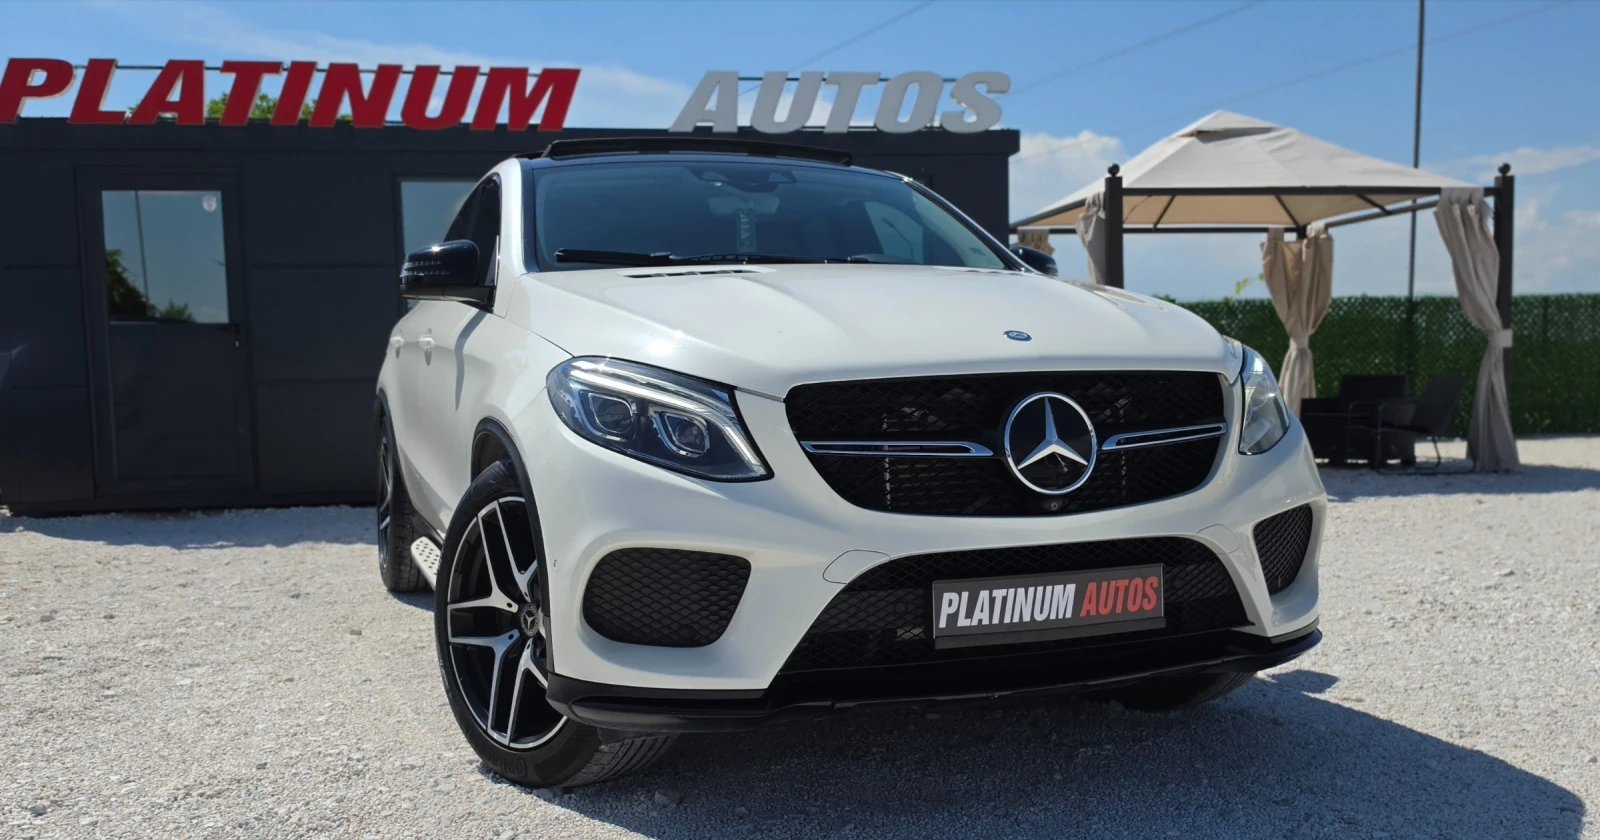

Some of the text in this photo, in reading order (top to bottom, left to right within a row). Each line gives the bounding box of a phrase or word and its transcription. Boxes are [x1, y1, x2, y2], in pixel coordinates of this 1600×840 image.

[0, 58, 1011, 134] PLATINUM AUTOS
[938, 576, 1159, 629] PLATINUM AUTOS
